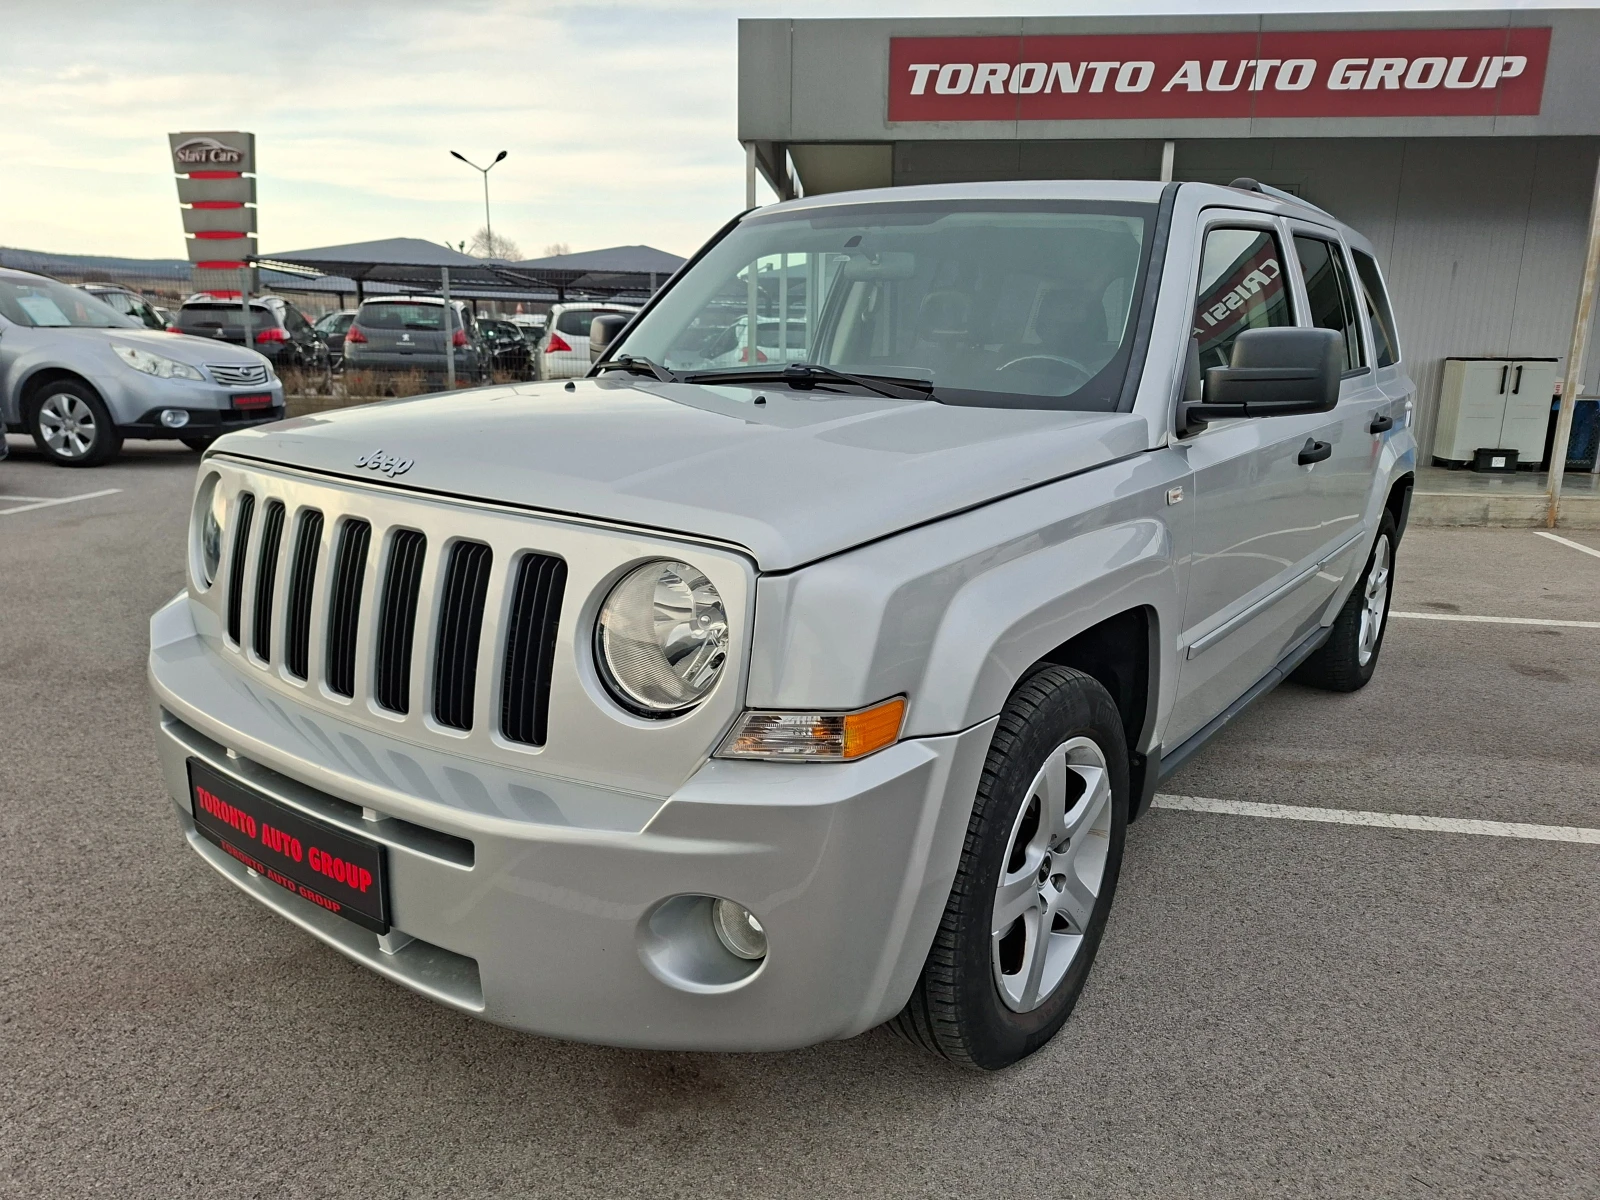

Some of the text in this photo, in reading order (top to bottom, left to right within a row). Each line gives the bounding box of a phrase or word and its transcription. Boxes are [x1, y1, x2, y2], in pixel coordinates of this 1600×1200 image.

[908, 55, 1527, 95] TORONTO AUTO GROUP
[177, 149, 240, 163] Slavi Cars
[354, 448, 415, 478] Jeep
[197, 786, 372, 893] TORONTO AUTO GROUP
[220, 840, 341, 913] TORONTO AUTO GROUP
